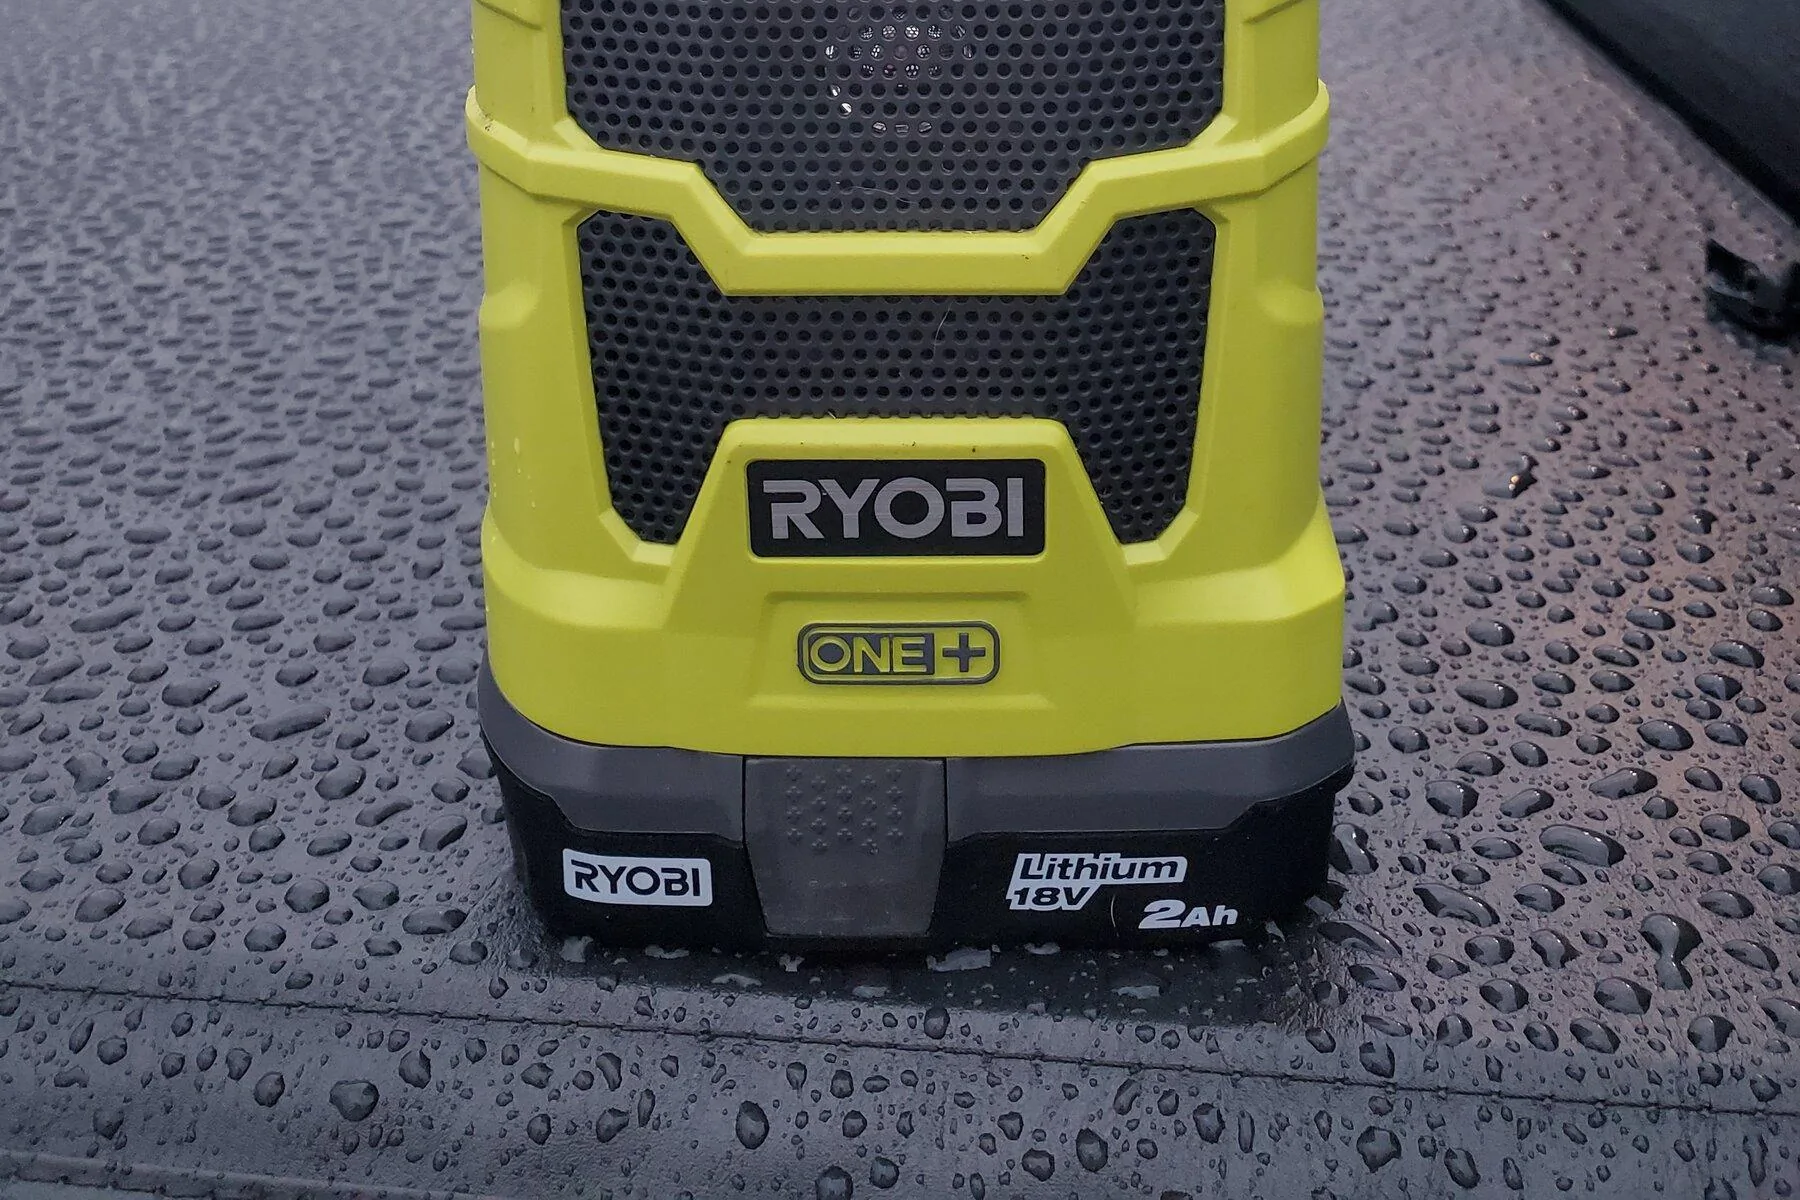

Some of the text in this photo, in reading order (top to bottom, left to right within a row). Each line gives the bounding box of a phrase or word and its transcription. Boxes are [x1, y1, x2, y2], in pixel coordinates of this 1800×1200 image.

[762, 476, 1025, 540] RYOBI
[570, 858, 702, 897] RYOBI
[1019, 856, 1180, 881] Lithium
[1013, 886, 1091, 906] 18V
[1137, 898, 1239, 930] 2Ah
